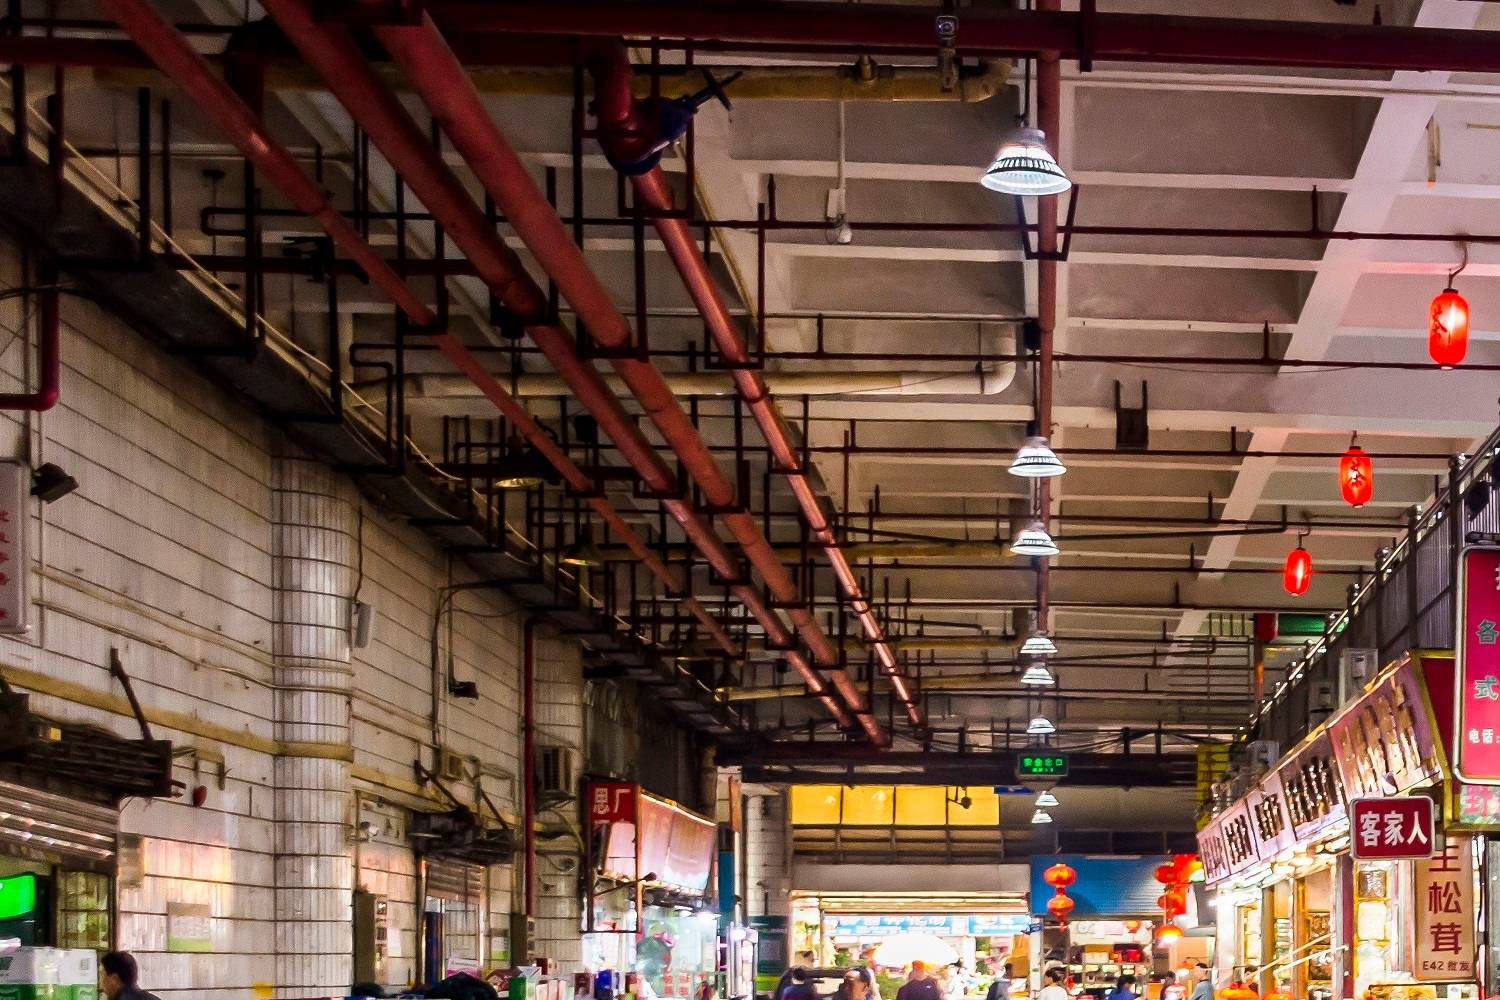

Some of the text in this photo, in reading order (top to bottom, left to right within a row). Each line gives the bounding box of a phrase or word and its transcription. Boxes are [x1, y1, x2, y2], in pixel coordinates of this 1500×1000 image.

[1359, 810, 1428, 848] 客家人
[1422, 960, 1445, 971] E42
